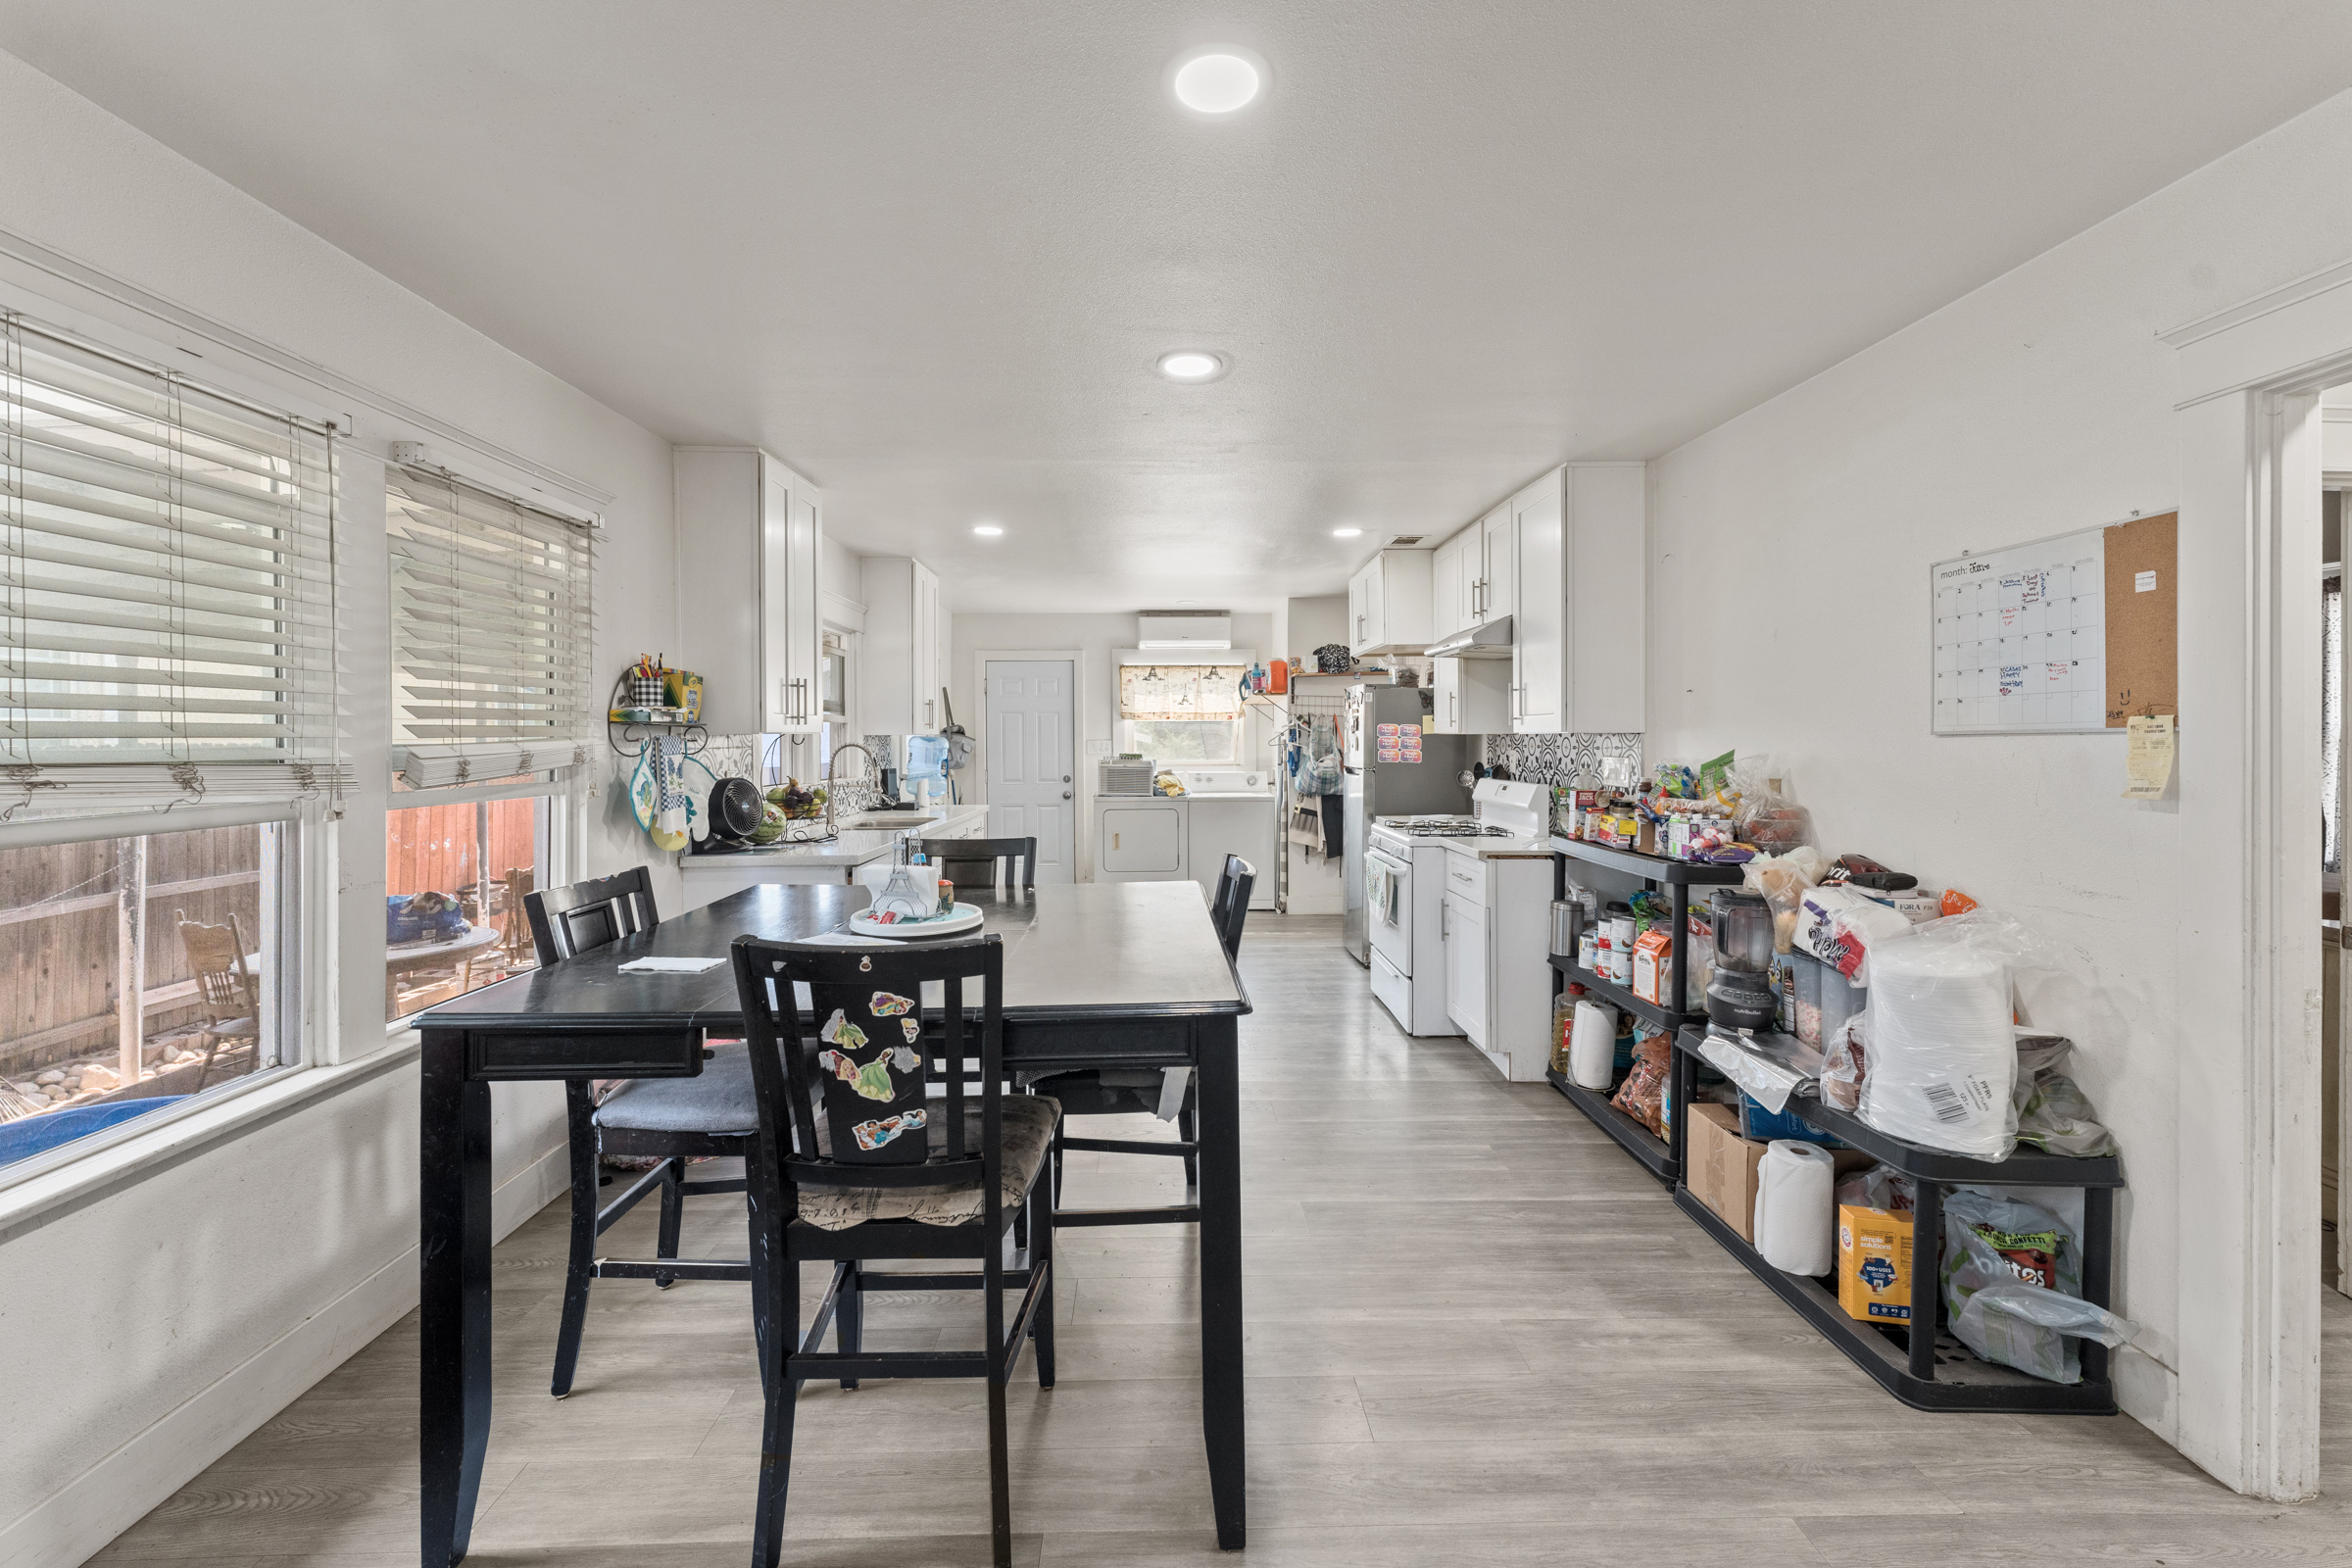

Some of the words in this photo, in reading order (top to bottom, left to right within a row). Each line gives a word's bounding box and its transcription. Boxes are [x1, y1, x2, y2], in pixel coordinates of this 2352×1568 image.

[1941, 566, 1967, 579] month:
[1970, 562, 1990, 573] June
[1980, 1080, 1992, 1099] PFR9
[1960, 1093, 1968, 1102] 125
[1971, 1081, 1982, 1096] FOAM
[1980, 1096, 1989, 1112] PLATE
